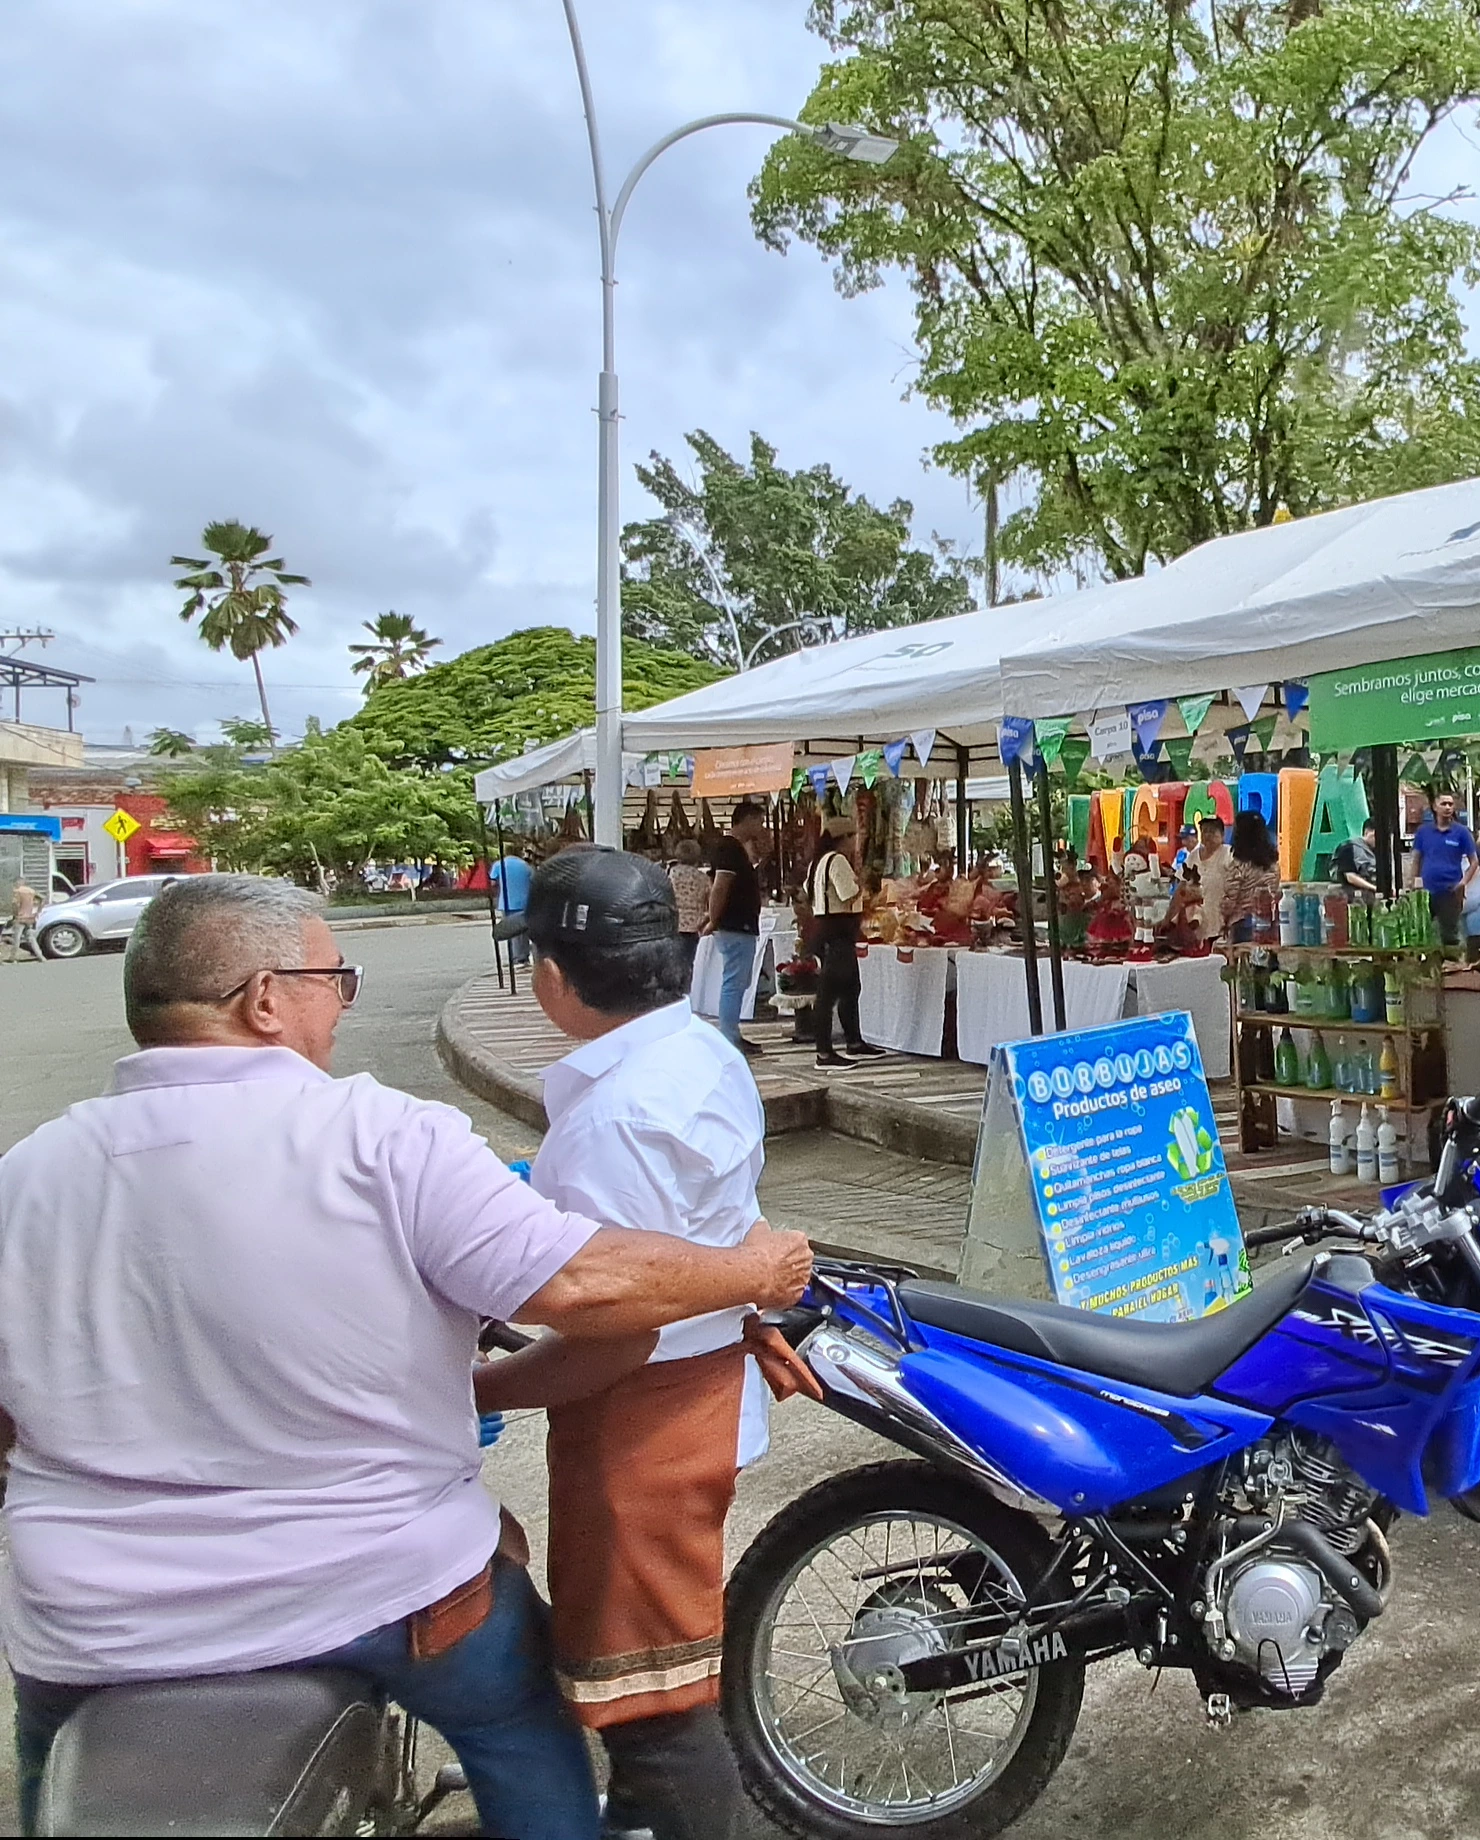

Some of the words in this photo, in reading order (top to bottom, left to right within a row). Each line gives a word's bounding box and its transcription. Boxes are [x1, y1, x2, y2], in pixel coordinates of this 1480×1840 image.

[1334, 674, 1411, 697] Sembramos
[1414, 666, 1462, 687] juntos,
[1401, 688, 1434, 706] elige
[1118, 720, 1130, 731] 10
[1137, 709, 1159, 725] pisa
[1032, 1043, 1188, 1099] BURBUJAS
[1053, 1090, 1128, 1121] Productos
[1130, 1083, 1148, 1101] de
[1150, 1077, 1182, 1097] aseo
[1089, 1285, 1129, 1311] MUCHOS
[1130, 1265, 1179, 1293] PRODUCTOS
[1137, 1296, 1148, 1310] EL
